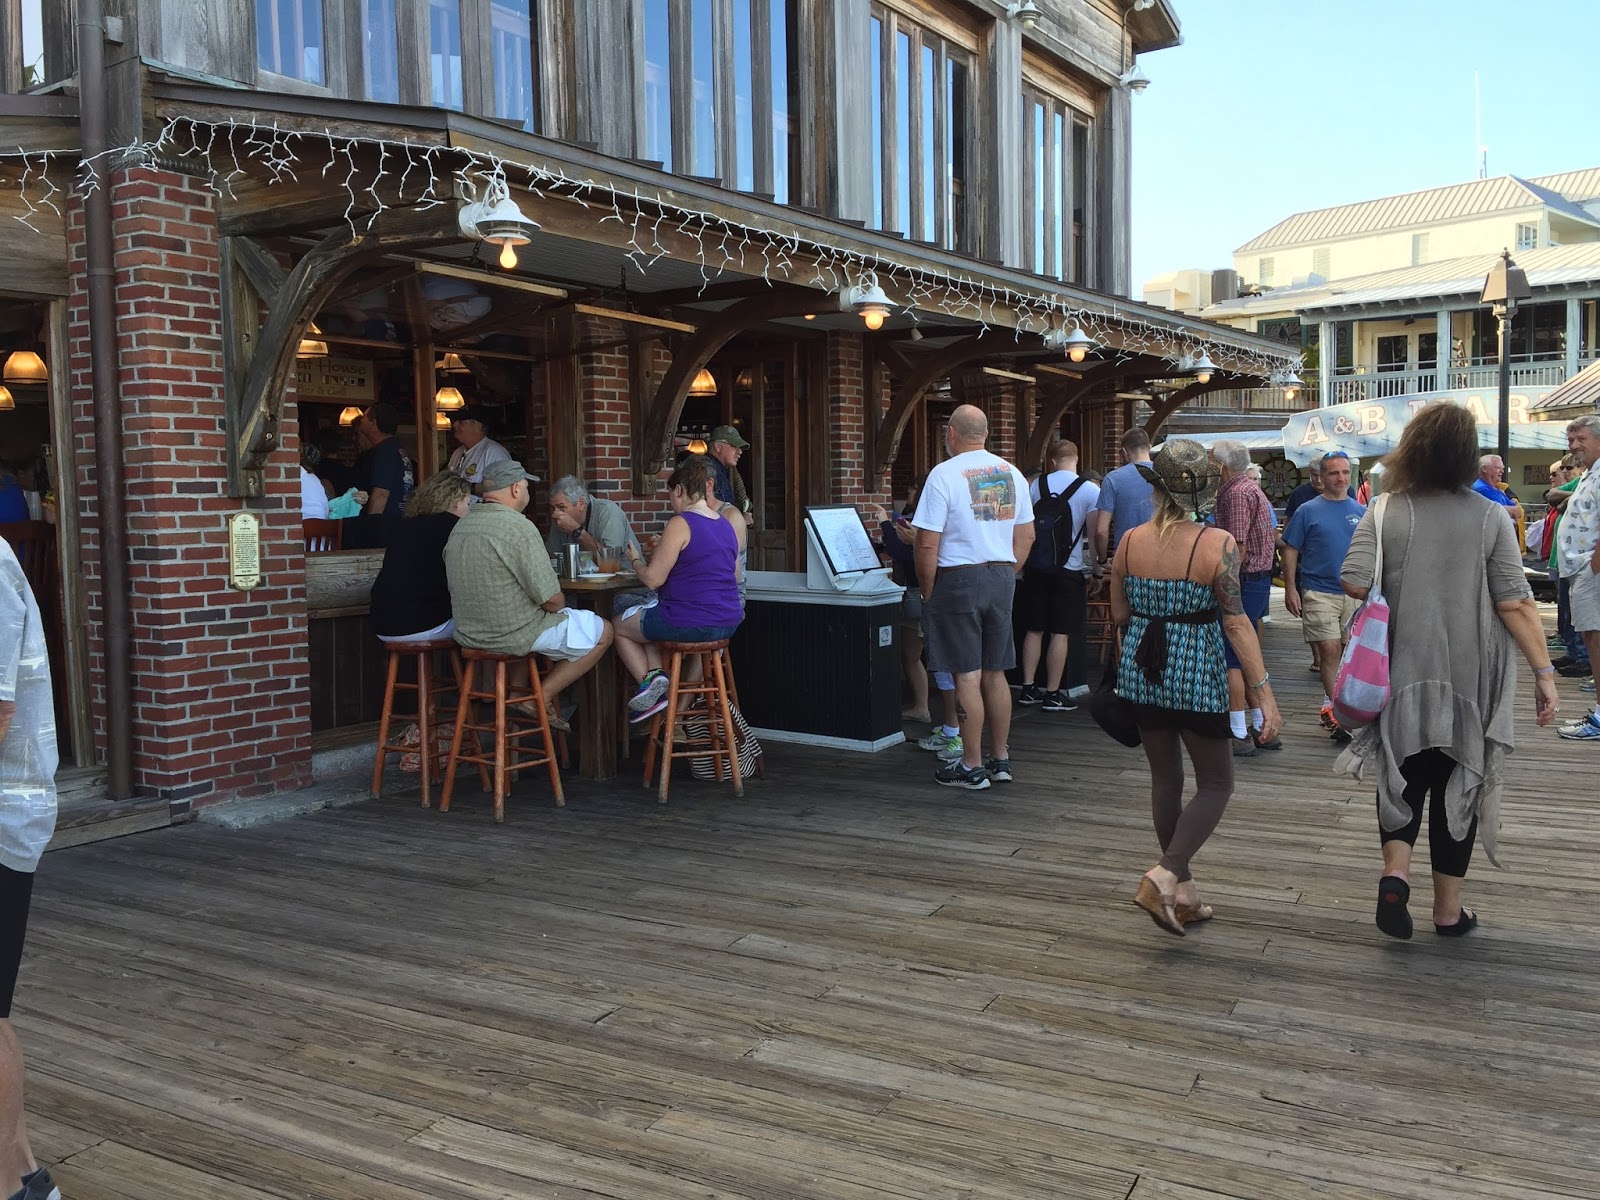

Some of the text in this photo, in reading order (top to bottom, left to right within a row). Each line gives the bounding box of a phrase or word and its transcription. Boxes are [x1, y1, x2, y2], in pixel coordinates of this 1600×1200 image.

[297, 359, 367, 375] at House
[1299, 415, 1330, 446] A
[1333, 415, 1354, 435] &
[1357, 405, 1387, 435] B
